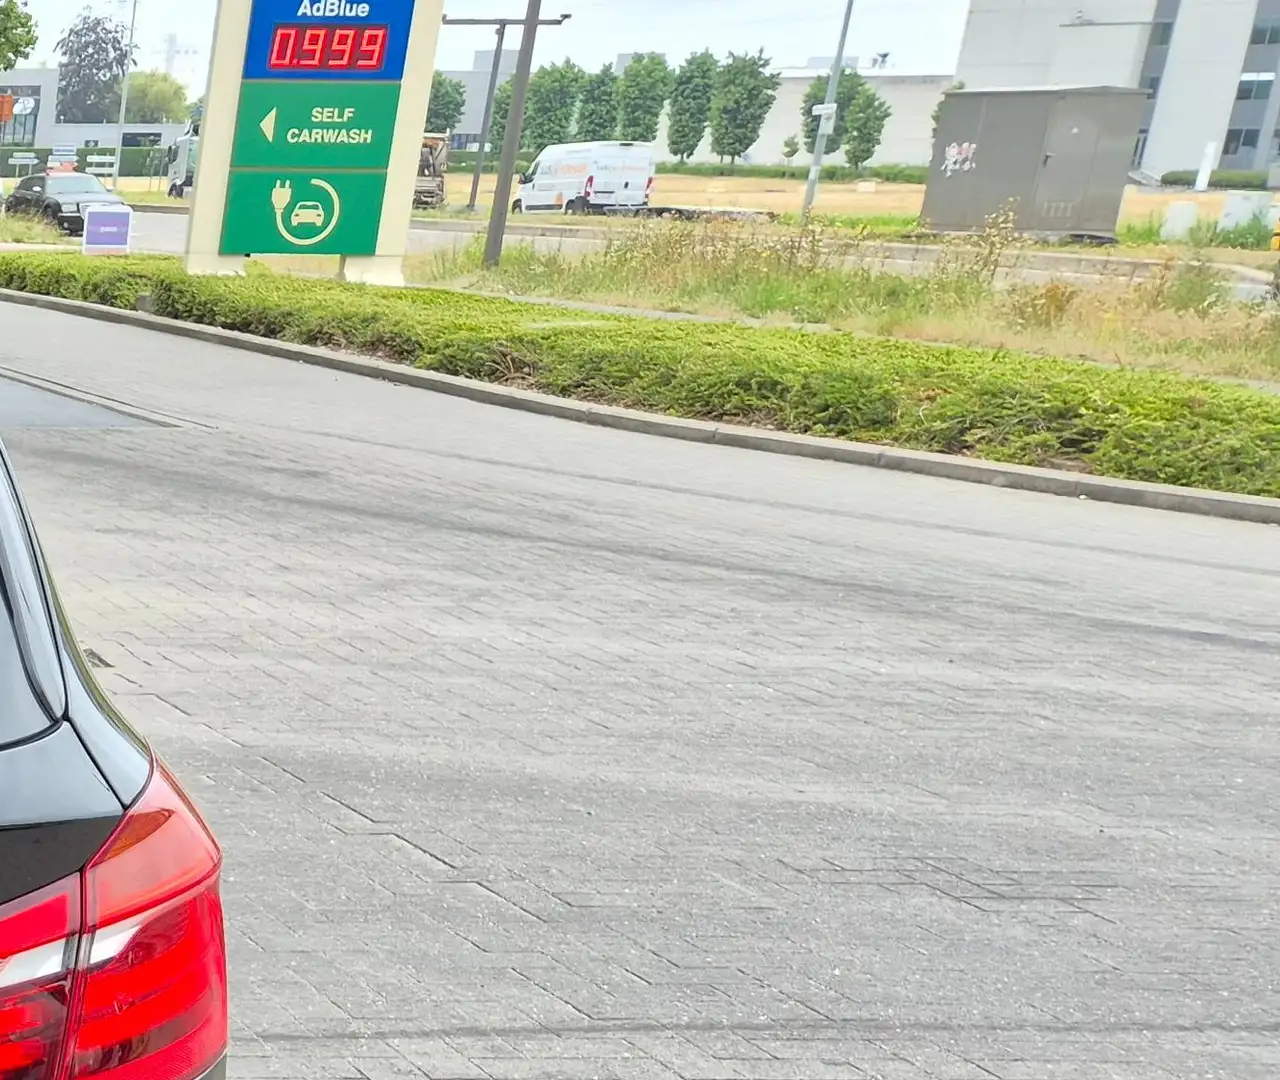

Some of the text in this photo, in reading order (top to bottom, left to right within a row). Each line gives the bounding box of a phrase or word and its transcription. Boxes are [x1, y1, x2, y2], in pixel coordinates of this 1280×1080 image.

[297, 0, 370, 17] AdBlue
[270, 28, 386, 67] 0.999
[311, 107, 355, 122] SELF
[286, 128, 373, 143] CARWASH
